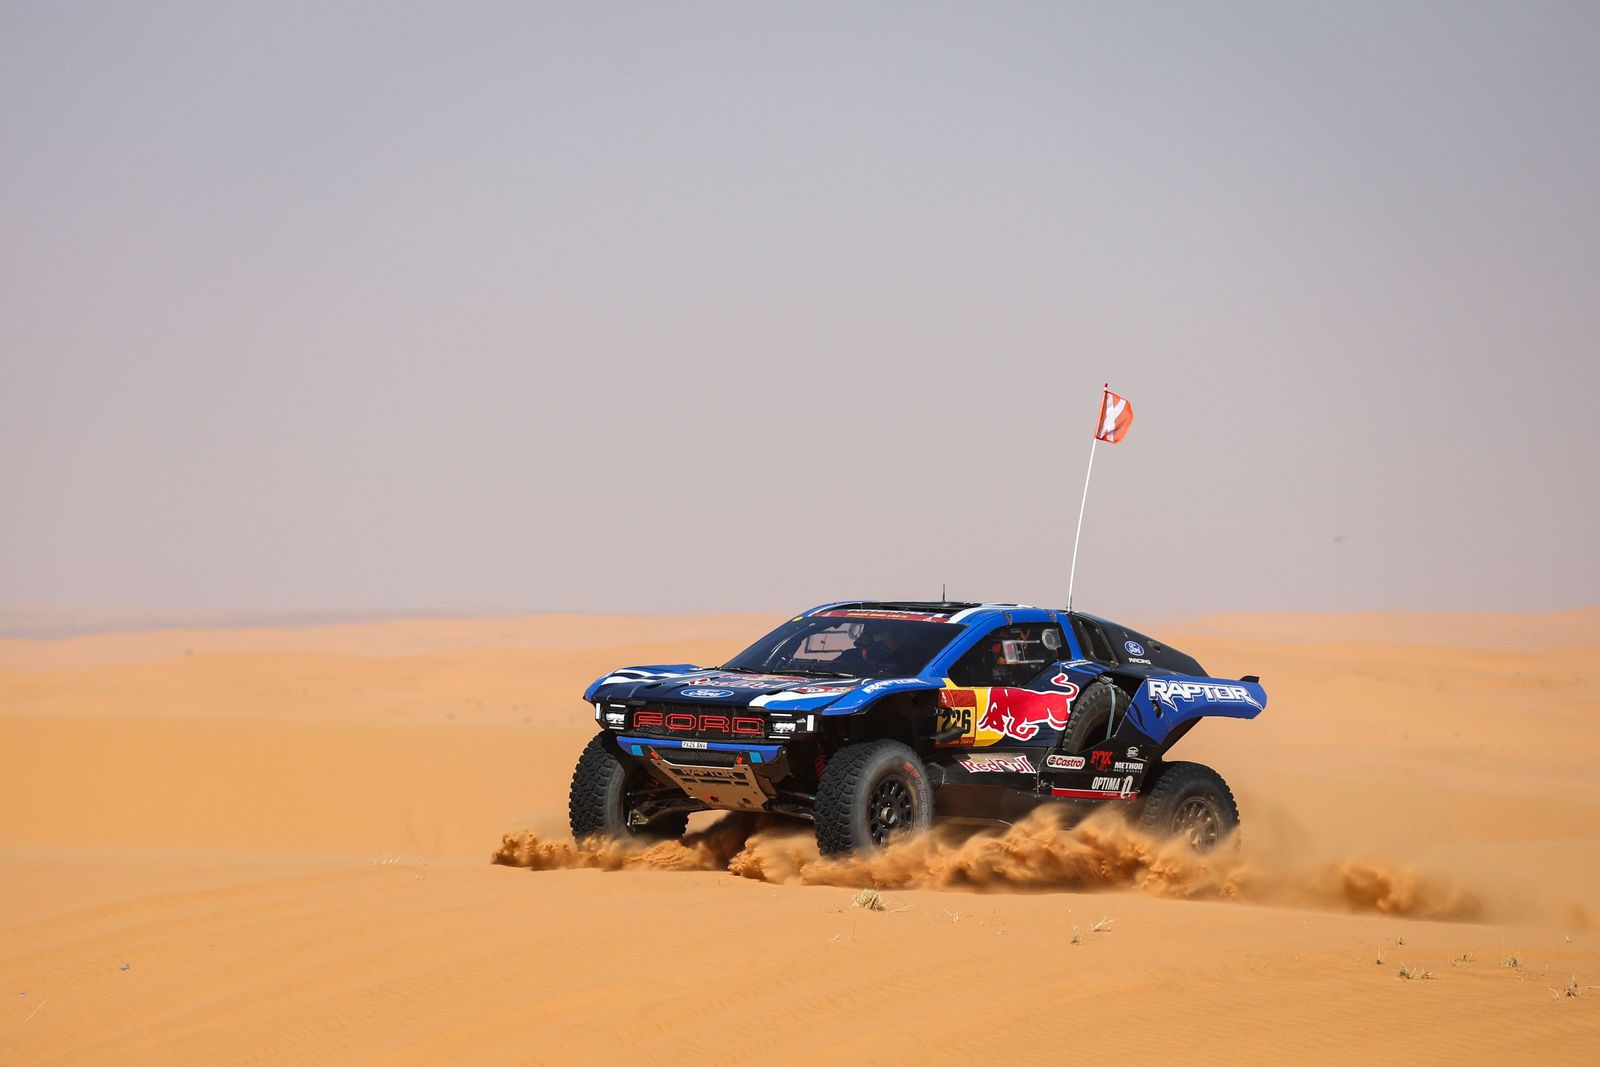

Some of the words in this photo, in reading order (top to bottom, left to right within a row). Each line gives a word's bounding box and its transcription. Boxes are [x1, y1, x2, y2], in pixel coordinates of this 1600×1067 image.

[1147, 678, 1263, 712] RAPTOR
[633, 711, 765, 735] FORD
[1055, 757, 1085, 768] Castrol
[1090, 750, 1113, 770] FOX
[1113, 761, 1144, 770] METHOD
[1091, 776, 1121, 790] OPTIMA
